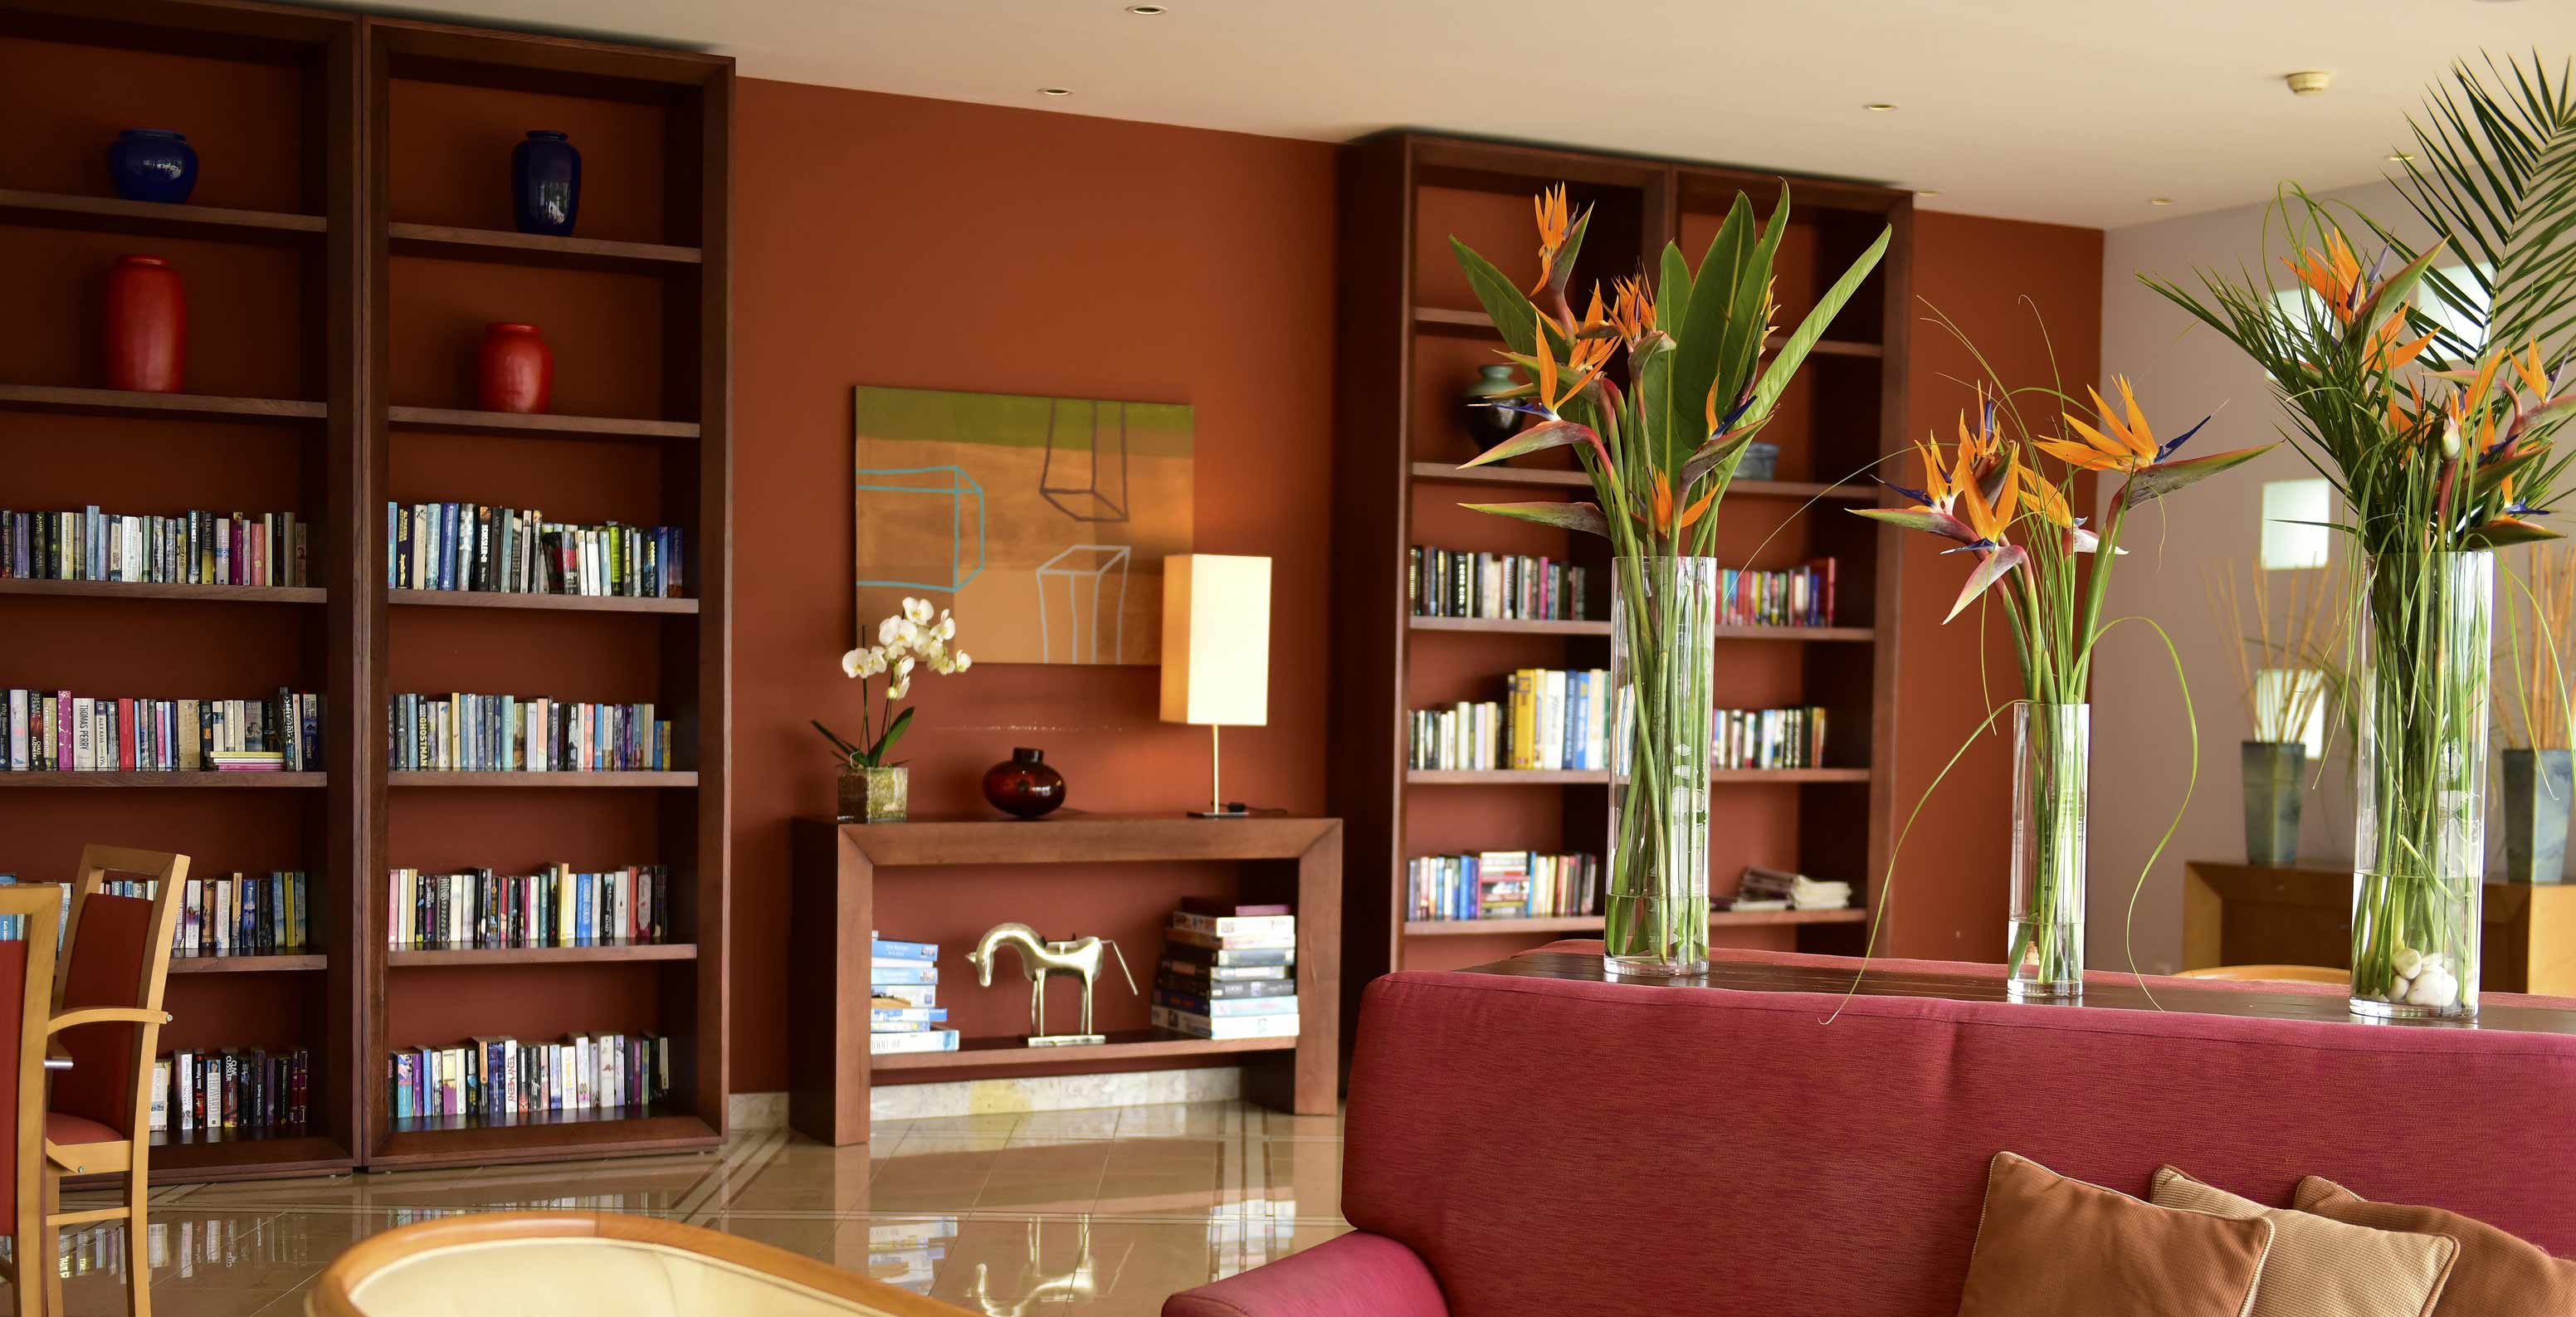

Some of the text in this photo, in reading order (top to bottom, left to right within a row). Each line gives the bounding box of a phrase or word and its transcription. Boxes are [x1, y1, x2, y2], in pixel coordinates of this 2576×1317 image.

[80, 705, 89, 750] THOMAS PERRY
[419, 717, 427, 767] GHOSTMAN
[209, 1080, 220, 1113] HOWARD
